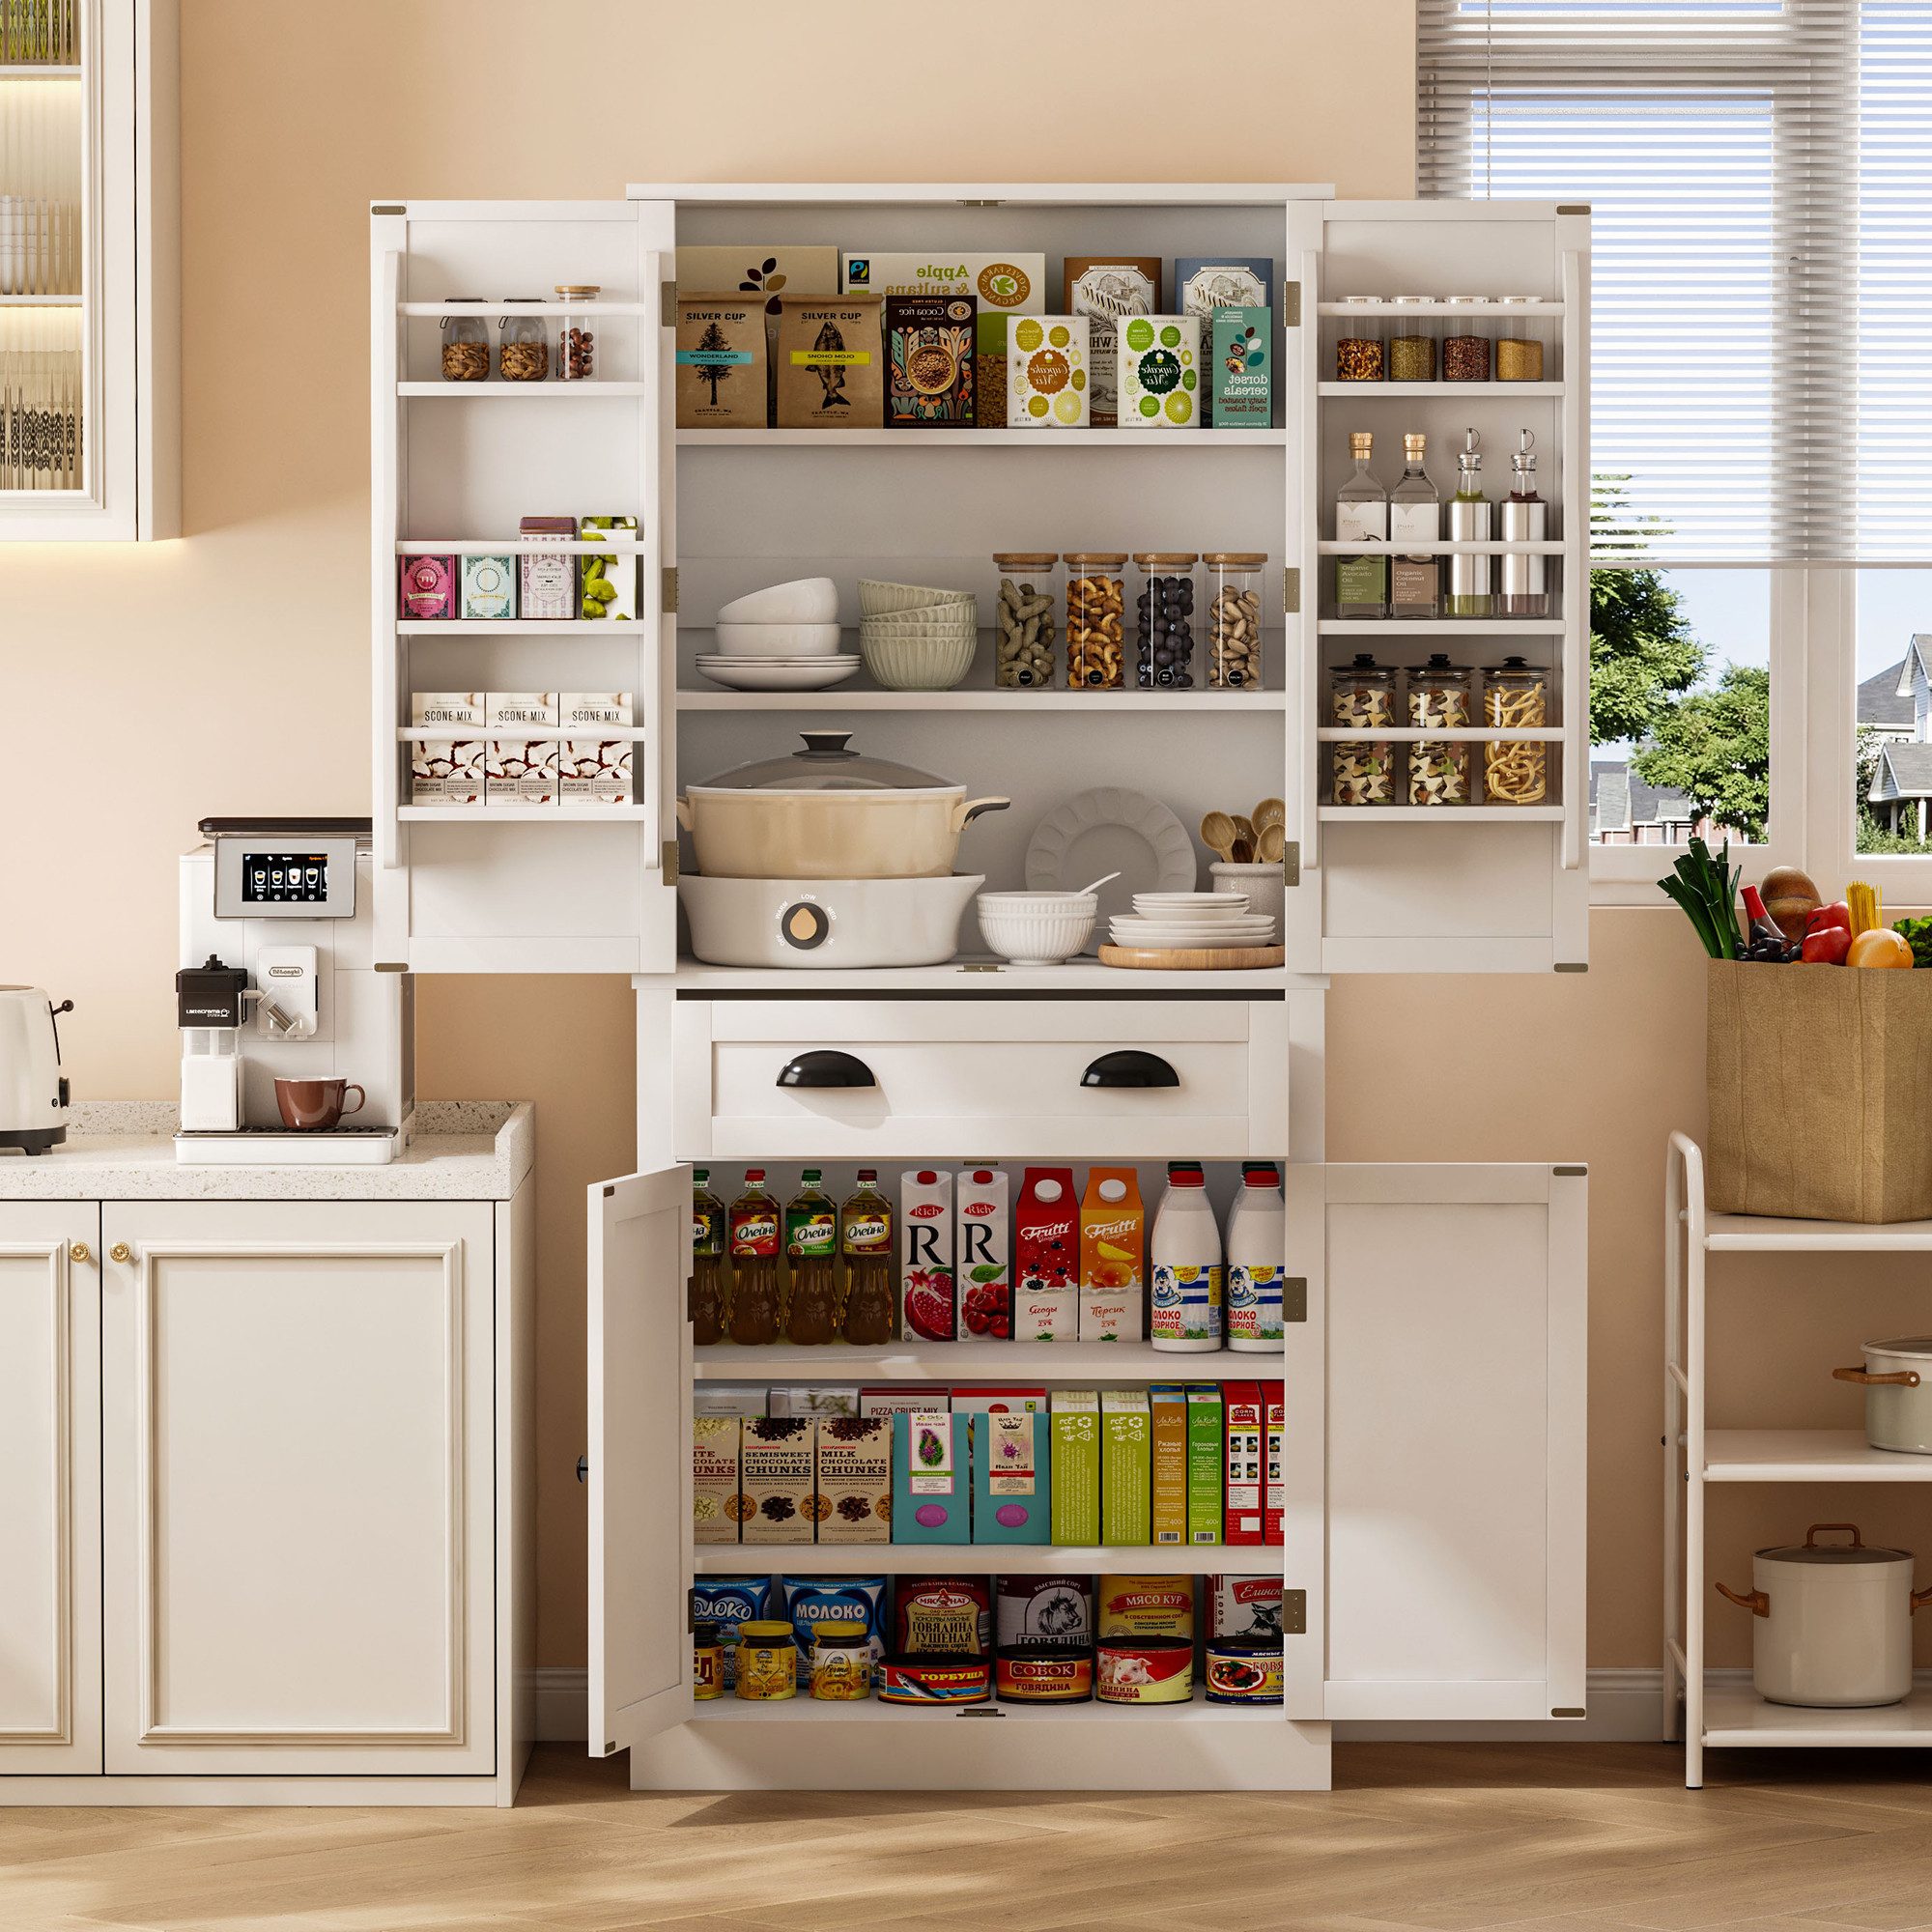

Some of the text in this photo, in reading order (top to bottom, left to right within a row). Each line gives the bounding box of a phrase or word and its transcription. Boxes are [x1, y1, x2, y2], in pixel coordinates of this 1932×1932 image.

[686, 312, 746, 321] SILVER CUP
[801, 312, 862, 321] SILVER CUP
[424, 710, 472, 722] SCONE MIX
[497, 710, 546, 722] SCONE MIX
[572, 710, 620, 722] SCONE MIX
[775, 900, 788, 920] WARM
[827, 905, 838, 921] MED
[915, 1207, 939, 1216] Rich
[968, 1206, 991, 1215] Rich
[737, 1226, 776, 1240] Олейна
[797, 1226, 834, 1241] Олейна
[846, 1225, 885, 1239] Олейна
[1020, 1221, 1070, 1240] Frutti
[1084, 1219, 1137, 1239] Frutti
[905, 1225, 947, 1265] R
[961, 1223, 1000, 1264] R
[1029, 1305, 1058, 1317] Ягоды
[1091, 1306, 1125, 1319] Персик
[1153, 1310, 1181, 1320] ОЛОКО
[1229, 1311, 1257, 1320] ОЛОКО
[870, 1406, 894, 1415] PIZZA
[694, 1465, 736, 1474] UNKS
[745, 1465, 811, 1474] CHUNKS
[1034, 1578, 1065, 1592] ВЫСШИЙ
[1125, 1595, 1182, 1606] МЯСО КУР
[796, 1604, 867, 1620] МОЛОКО
[912, 1622, 974, 1633] ГОВЯДИНА
[915, 1633, 972, 1643] ТУШЕНАЯ
[1012, 1664, 1073, 1675] СОВОК
[920, 1670, 984, 1681] ГОРБУША
[1015, 1683, 1071, 1691] ГОВЯДИНА
[1100, 1685, 1140, 1693] СВИНИНА
